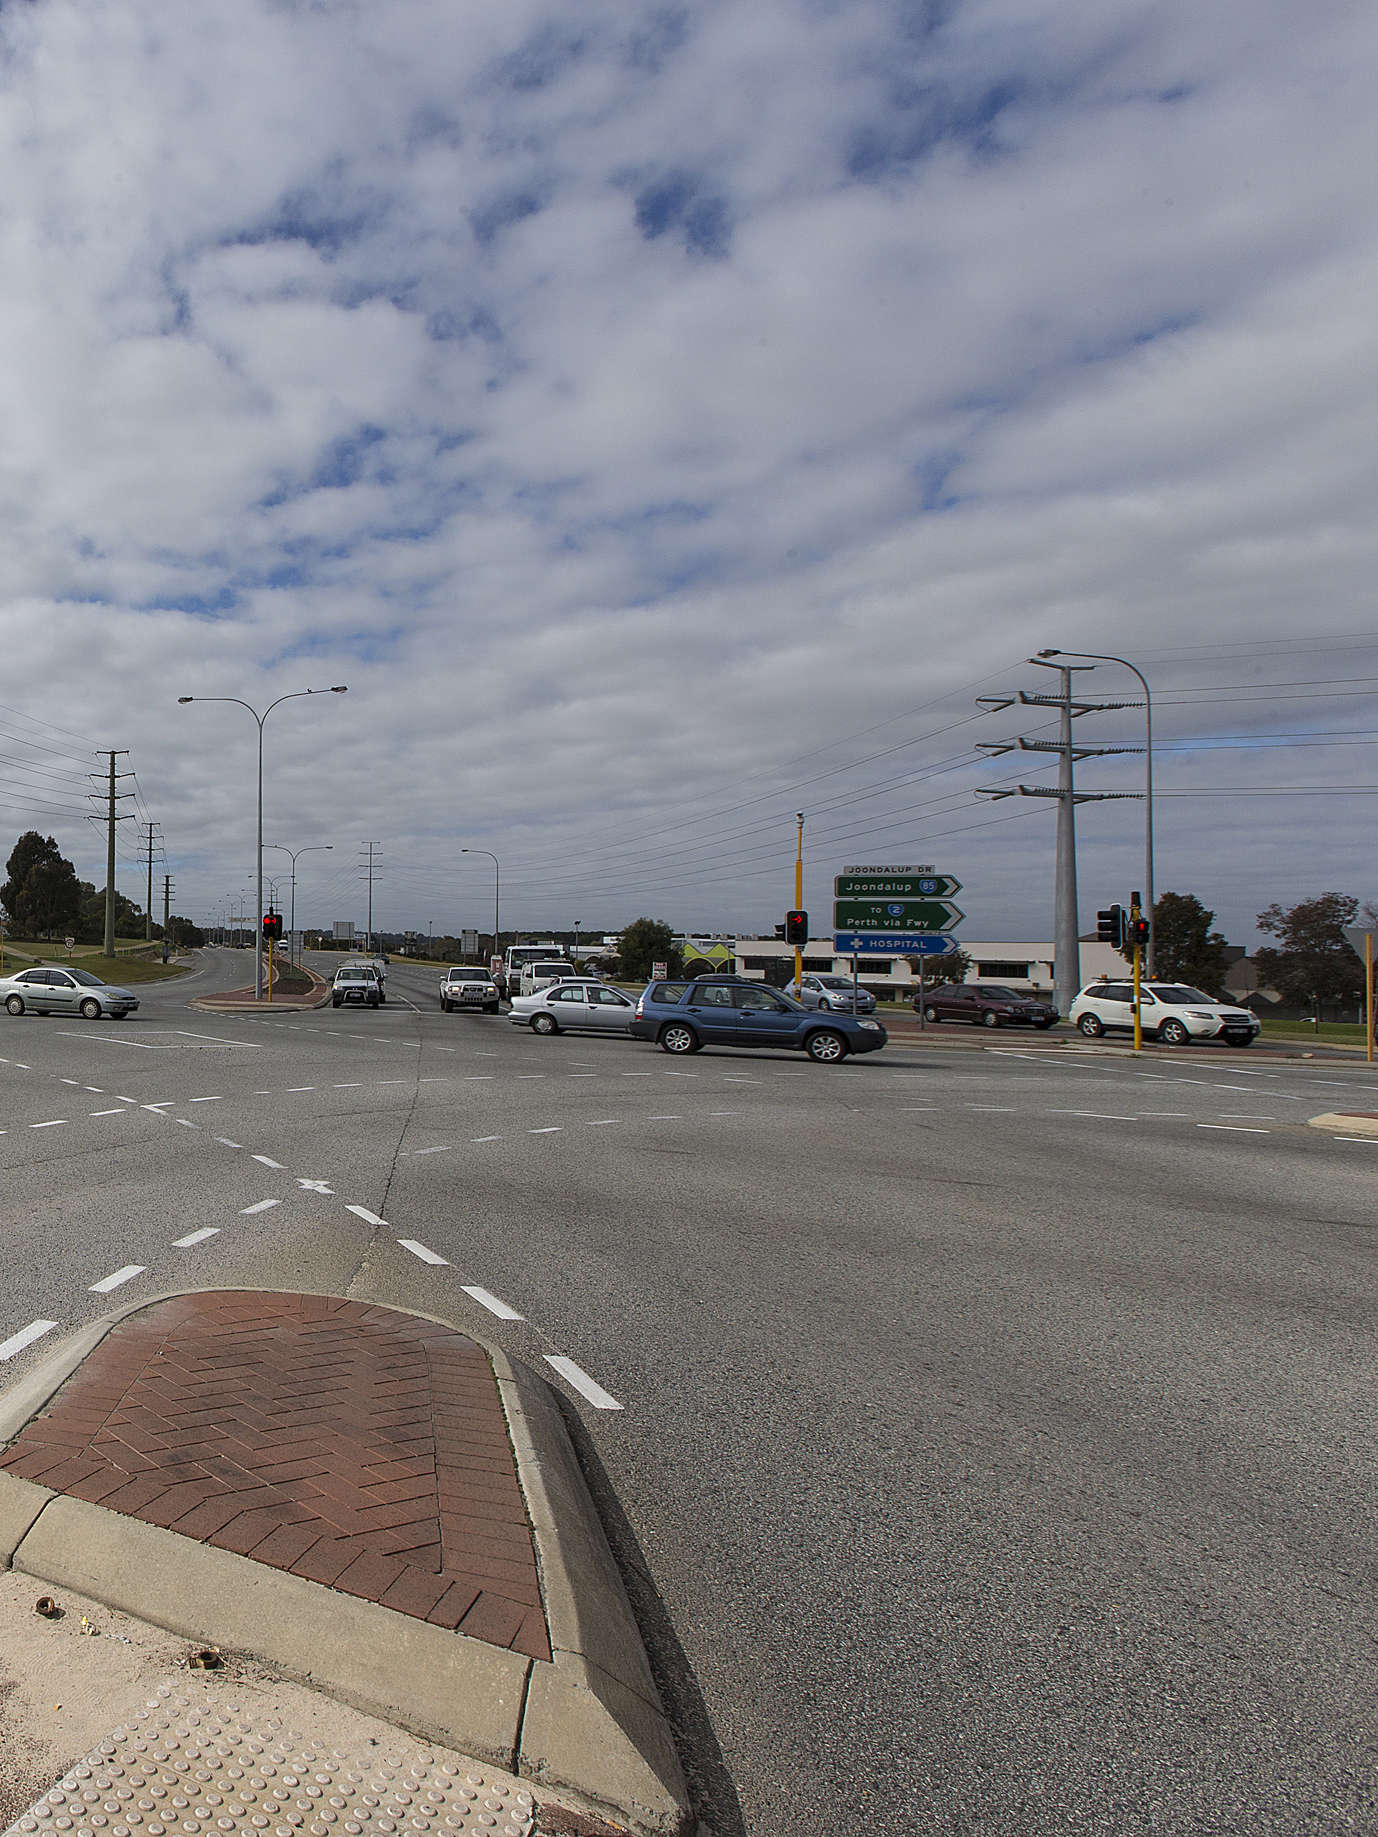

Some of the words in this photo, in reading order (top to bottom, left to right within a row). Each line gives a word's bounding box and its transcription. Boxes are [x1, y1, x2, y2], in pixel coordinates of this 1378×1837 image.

[848, 866, 912, 874] JOONDALUP
[845, 882, 912, 892] Joondalup
[922, 882, 935, 890] 85
[892, 906, 901, 914] 2
[846, 918, 878, 926] Perth
[883, 919, 901, 927] via
[906, 919, 929, 928] Fwy
[869, 940, 928, 949] HOSPITAL
